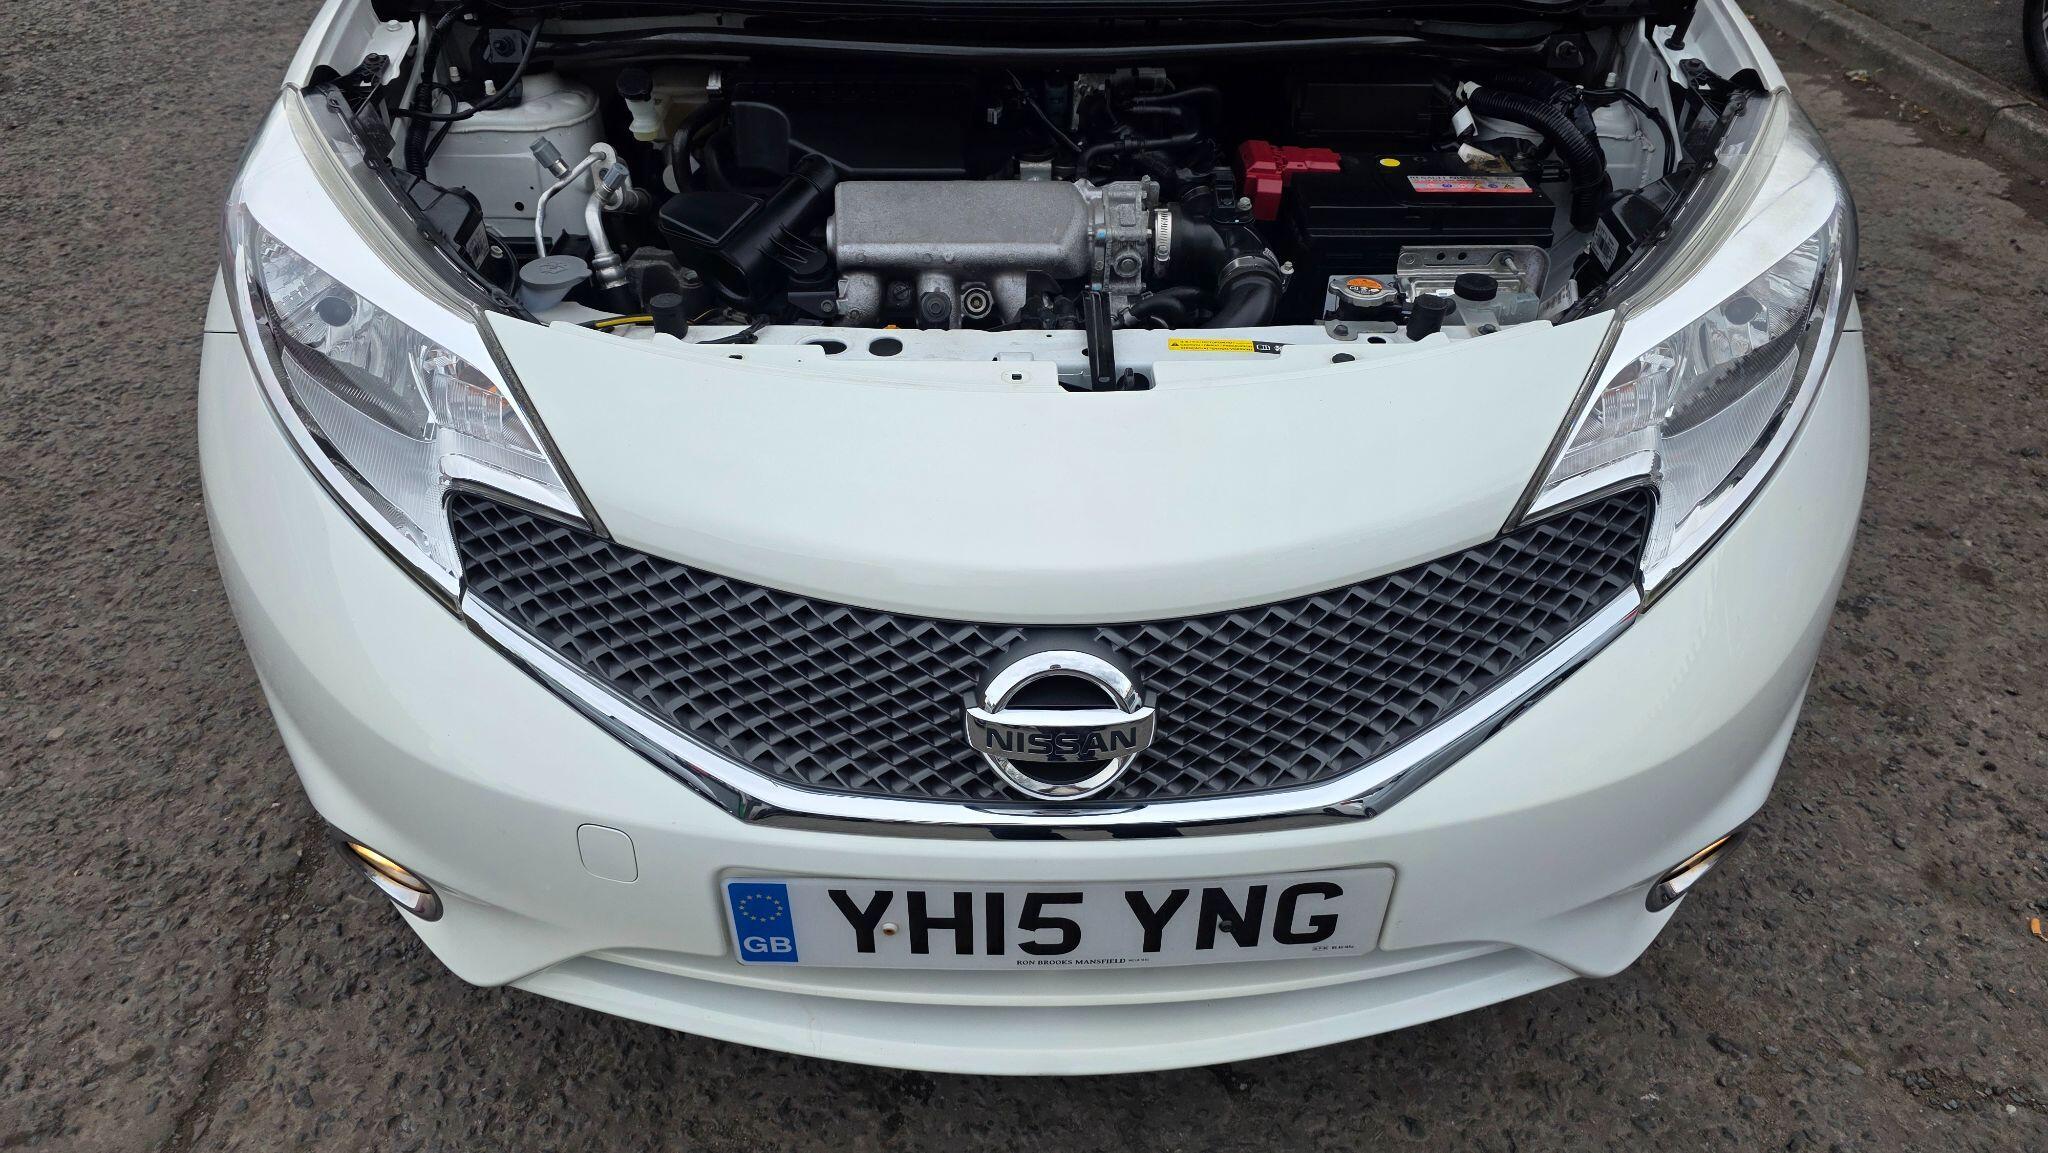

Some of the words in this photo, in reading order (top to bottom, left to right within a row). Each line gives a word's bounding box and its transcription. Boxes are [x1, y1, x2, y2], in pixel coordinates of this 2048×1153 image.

[986, 726, 1137, 756] NISSAN
[828, 889, 1083, 956] YH15
[1124, 881, 1344, 953] YNG
[743, 935, 793, 953] GB
